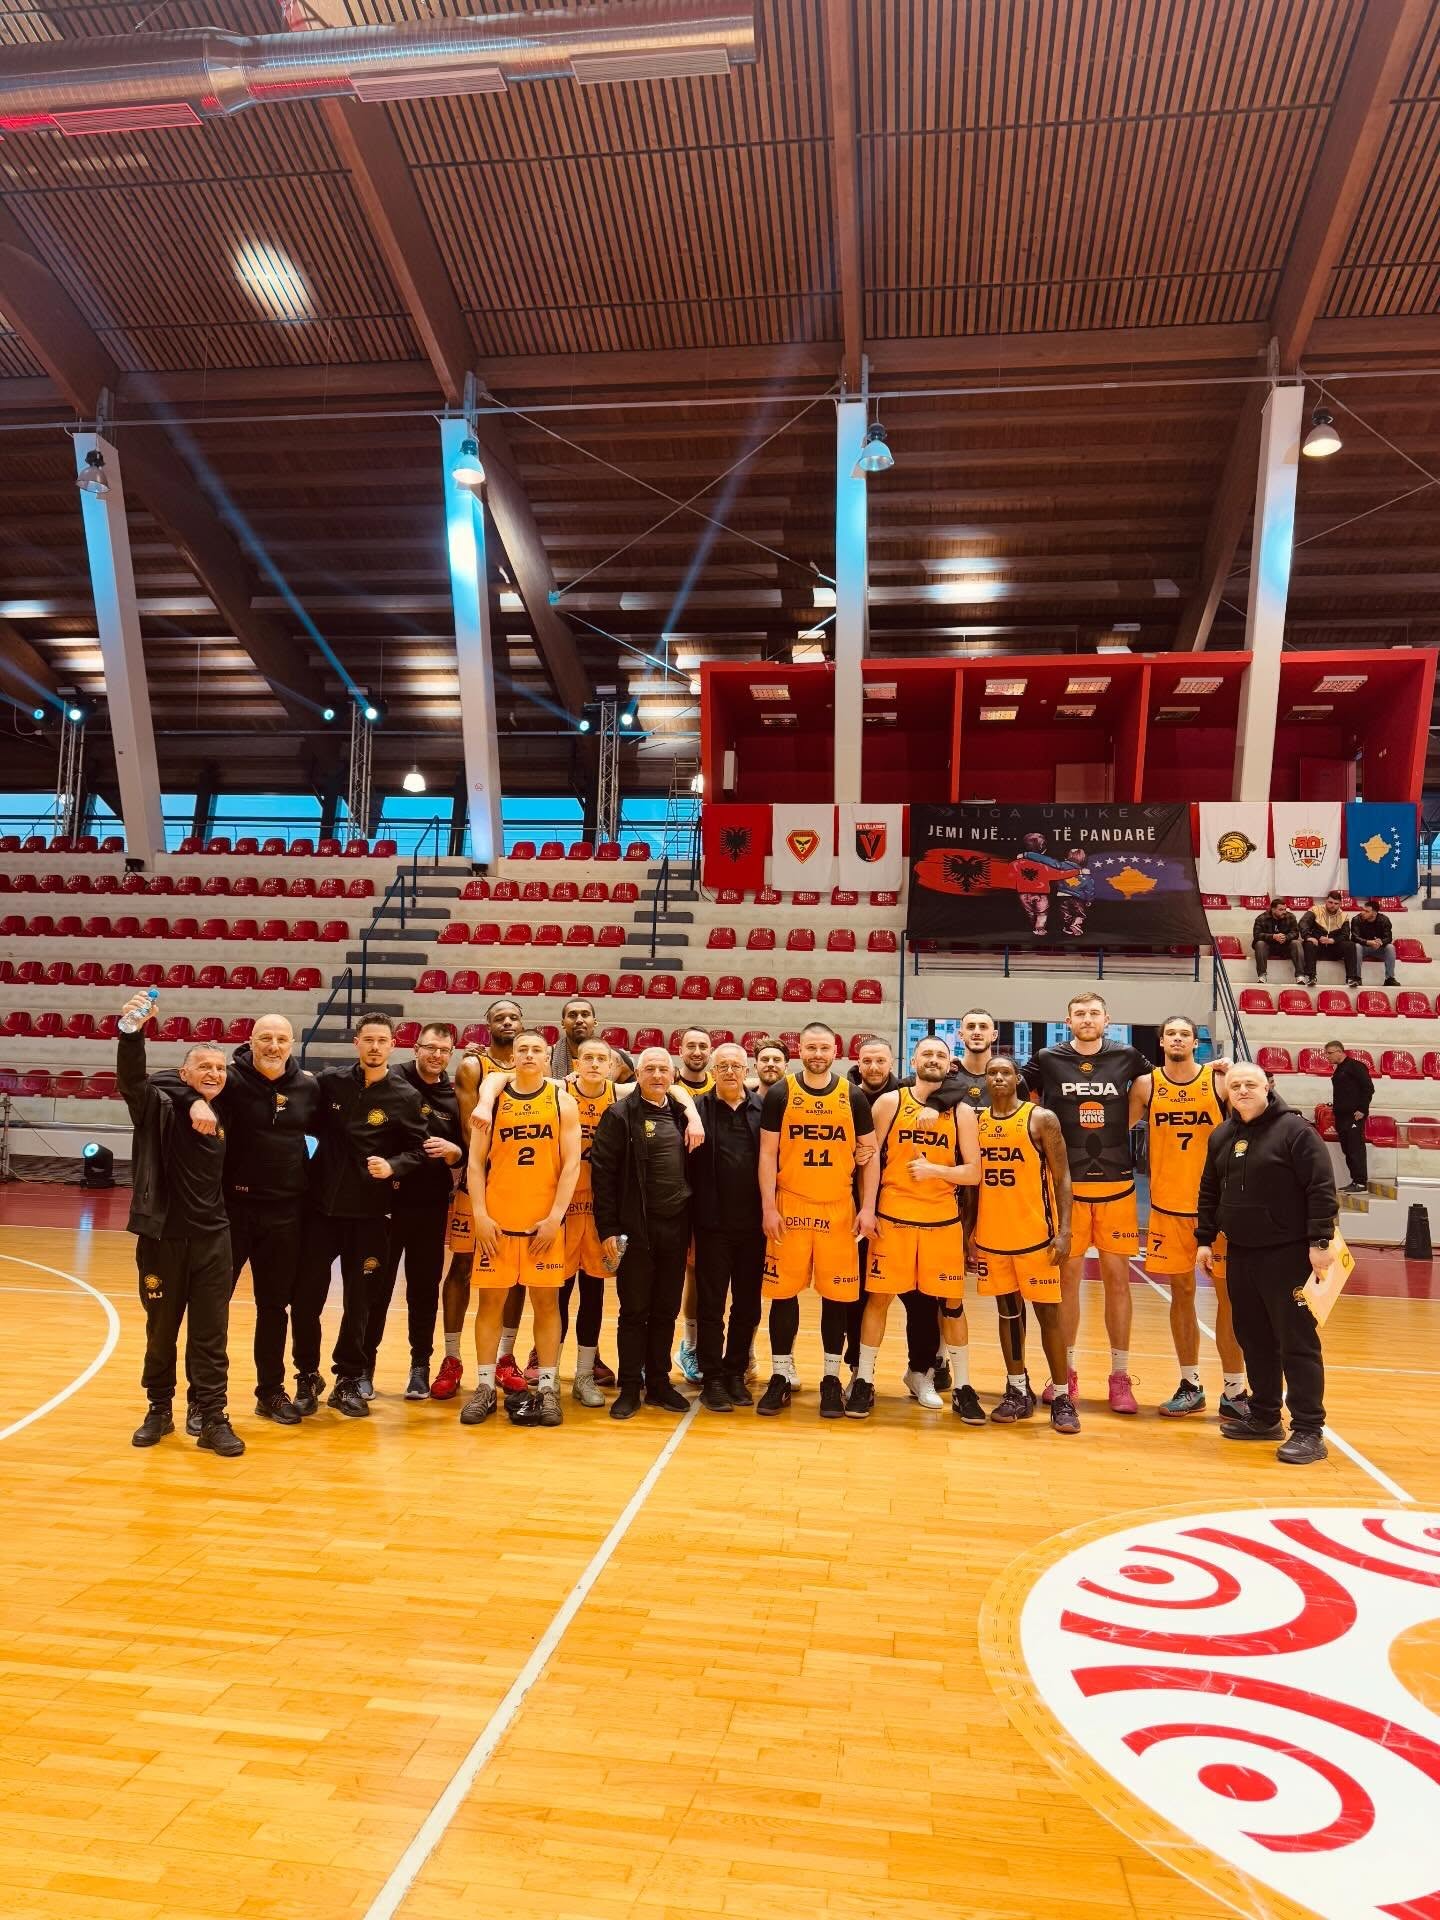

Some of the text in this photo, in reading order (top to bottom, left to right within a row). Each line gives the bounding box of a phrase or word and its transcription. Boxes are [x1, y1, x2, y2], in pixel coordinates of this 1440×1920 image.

[960, 808, 1129, 818] LIGA UNIKE
[927, 825, 1017, 841] JEMI NJË...
[1053, 826, 1156, 841] TË PANDARË
[1297, 849, 1319, 858] YLLI
[1061, 1082, 1119, 1096] PEJA
[1080, 1115, 1105, 1123] KING
[1155, 1111, 1213, 1126] PEJA
[499, 1124, 553, 1142] PEJA
[788, 1124, 846, 1141] PEJA
[898, 1129, 949, 1149] PEJA
[1177, 1132, 1193, 1150] 7
[517, 1146, 536, 1166] 2
[803, 1149, 833, 1167] 11
[980, 1147, 1025, 1162] PEJA
[984, 1168, 1016, 1187] 55
[451, 1218, 471, 1234] 21
[785, 1217, 830, 1229] DENT FIX
[1152, 1239, 1162, 1252] 7
[870, 1259, 881, 1275] 1
[148, 1291, 163, 1299] MJ
